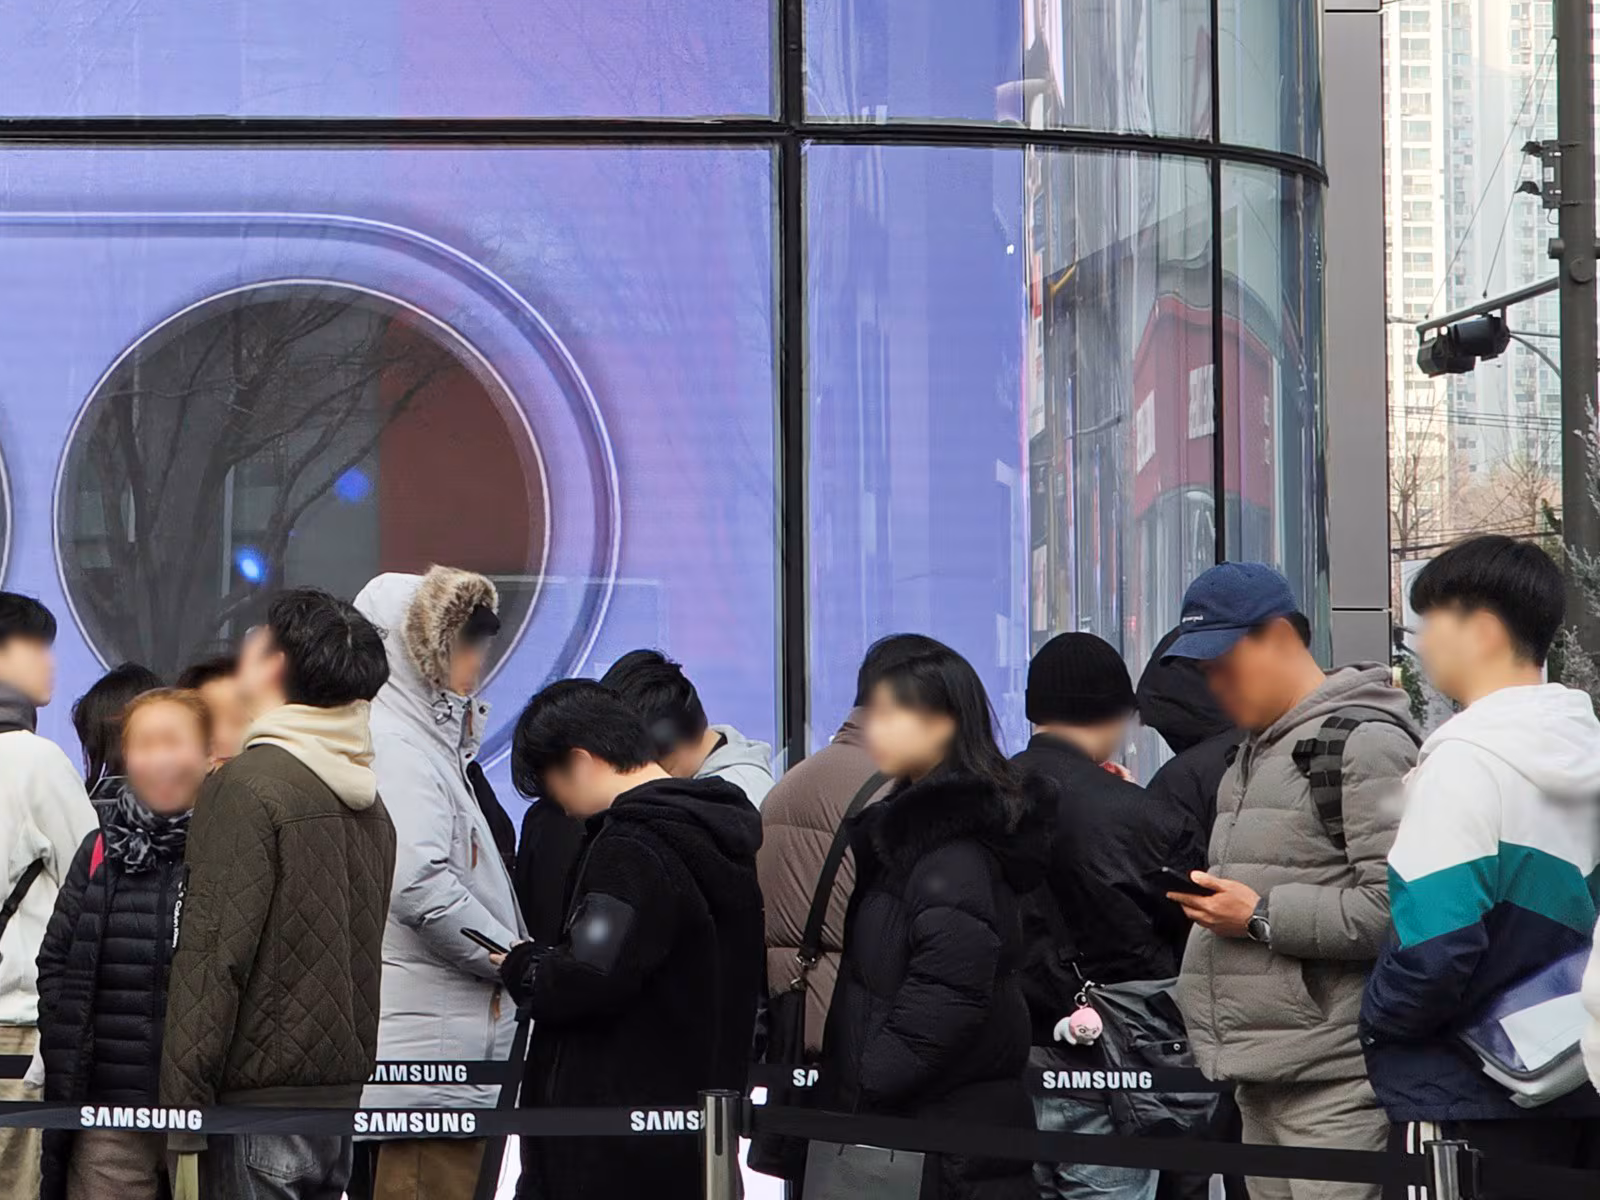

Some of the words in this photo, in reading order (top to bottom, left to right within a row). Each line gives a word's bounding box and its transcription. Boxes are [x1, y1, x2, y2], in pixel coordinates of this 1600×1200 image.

[368, 1064, 468, 1082] AMSUNG
[1042, 1070, 1152, 1089] SAMSUNG
[80, 1105, 203, 1131] SAMSUNG
[353, 1111, 476, 1133] SAMSUNG
[630, 1110, 701, 1132] SAMS
